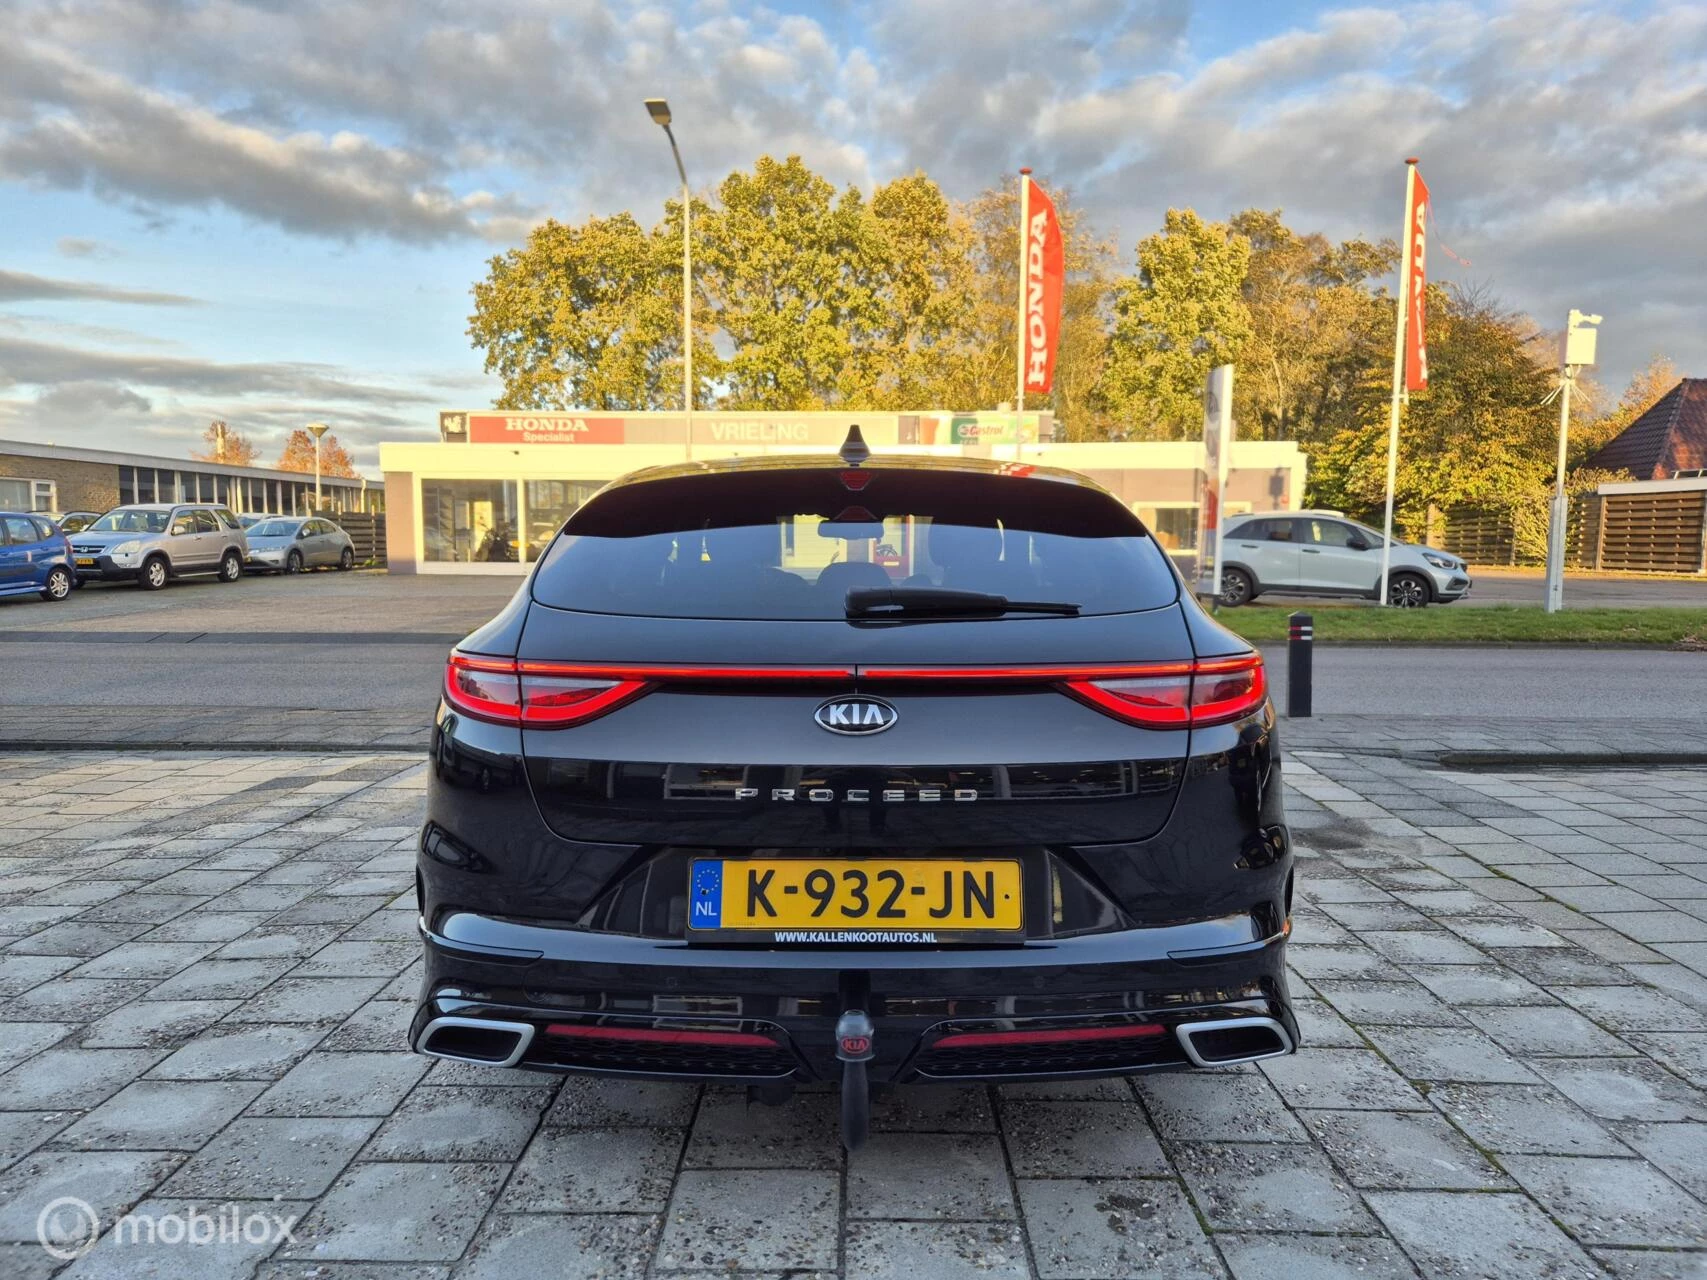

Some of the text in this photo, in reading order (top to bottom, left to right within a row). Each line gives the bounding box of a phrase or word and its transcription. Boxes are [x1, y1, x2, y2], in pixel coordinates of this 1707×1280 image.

[1028, 208, 1048, 386] HONDA
[505, 418, 589, 432] HONDA
[710, 422, 809, 441] VRIELING
[523, 432, 575, 443] Specialist
[829, 703, 885, 725] KIA
[735, 787, 979, 802] PROCEED
[746, 868, 996, 919] K-932-JN
[695, 901, 718, 917] NL
[774, 930, 938, 944] WWW.KALLENKOOTAUTOS.NL
[844, 1039, 866, 1049] KIA
